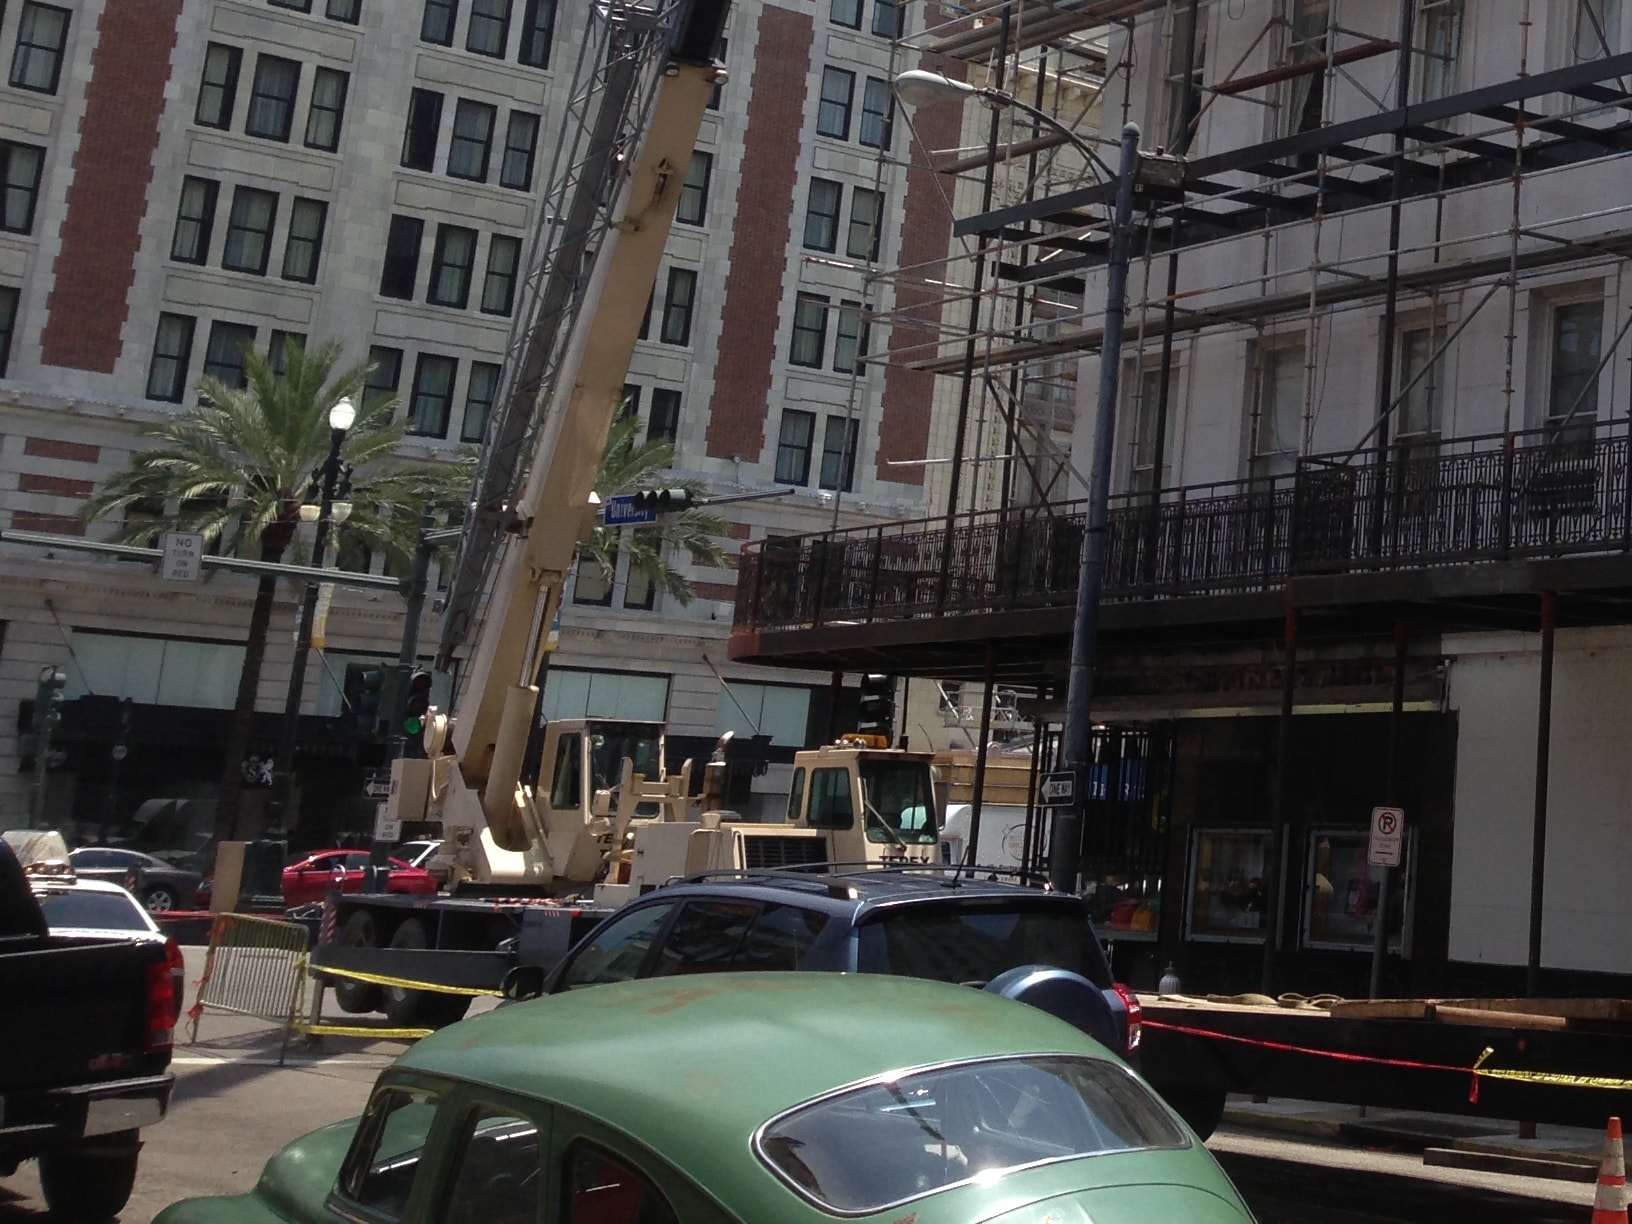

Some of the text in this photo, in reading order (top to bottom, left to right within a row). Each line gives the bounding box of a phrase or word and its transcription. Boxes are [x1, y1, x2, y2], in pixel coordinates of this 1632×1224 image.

[176, 538, 192, 548] NO
[172, 549, 194, 557] TURN
[176, 560, 188, 568] ON
[172, 569, 189, 578] RED
[1050, 782, 1071, 795] ONE WAY
